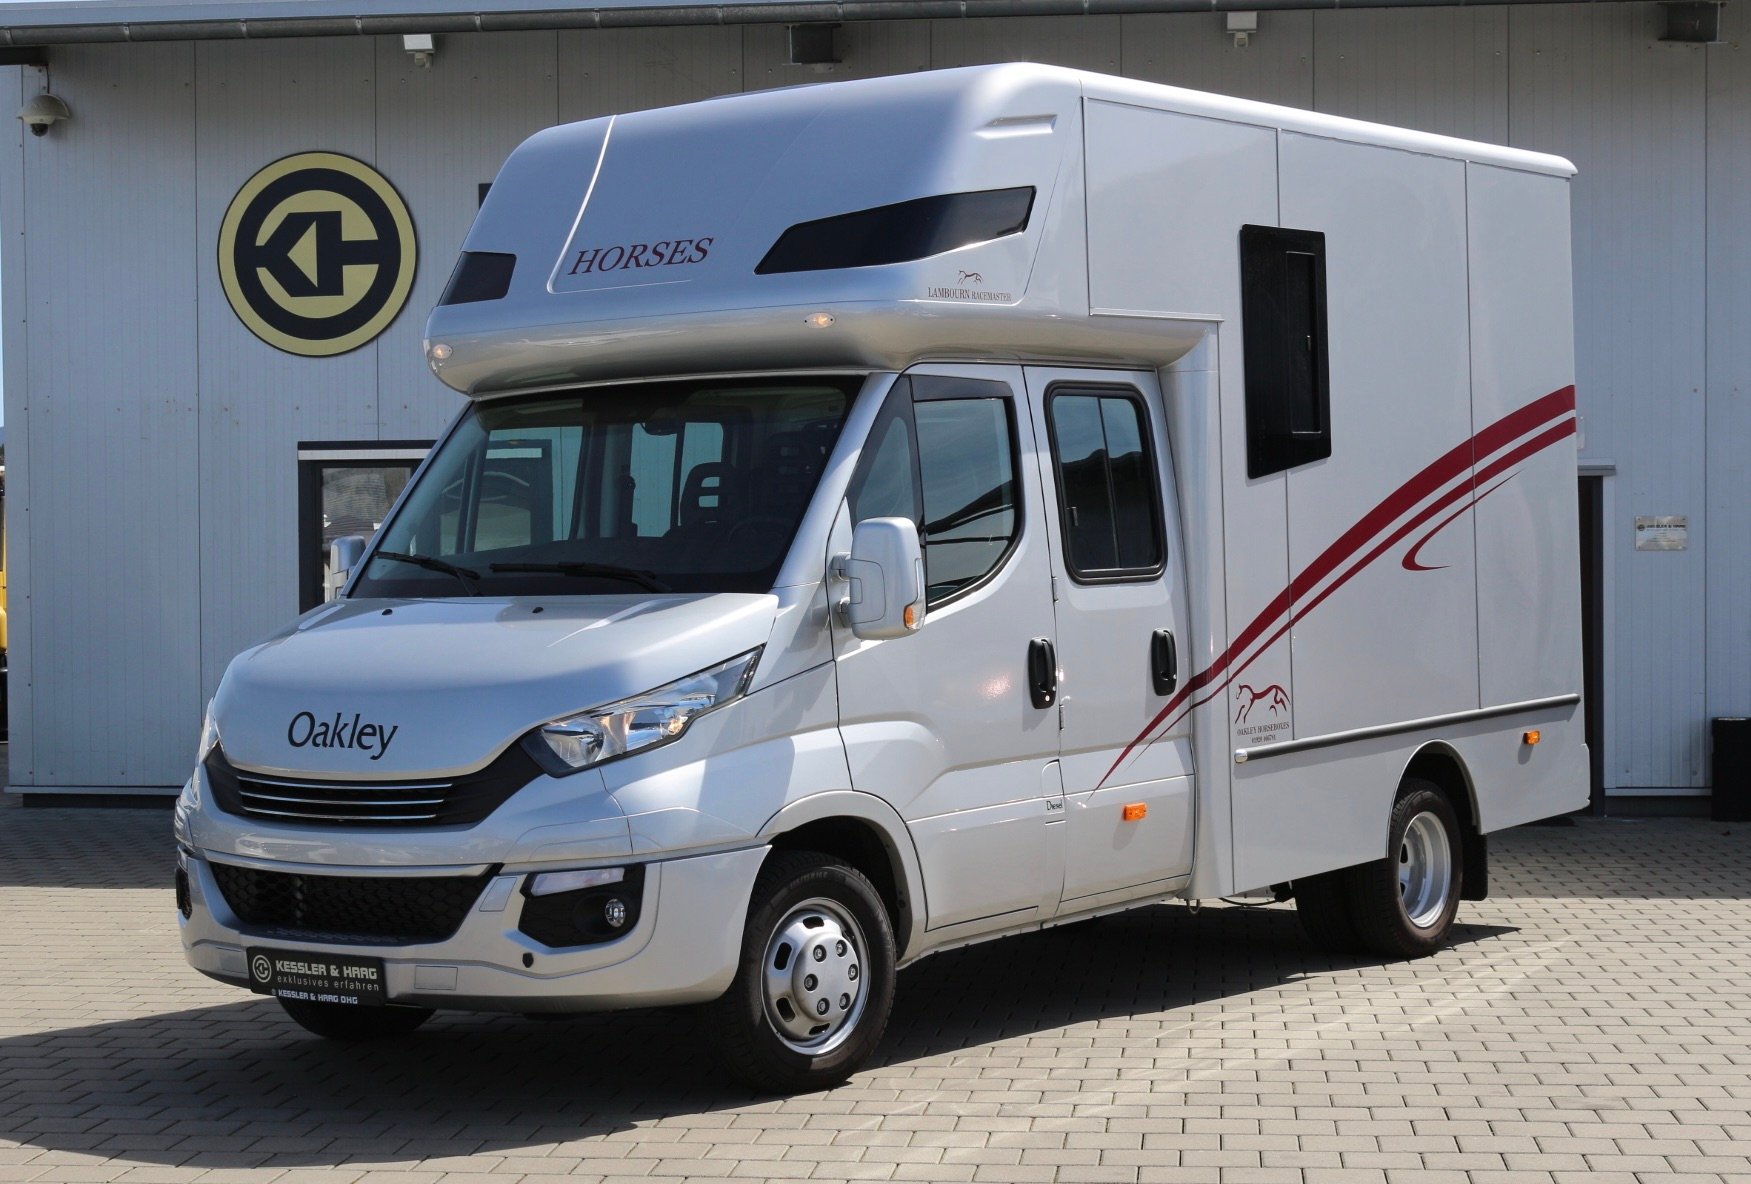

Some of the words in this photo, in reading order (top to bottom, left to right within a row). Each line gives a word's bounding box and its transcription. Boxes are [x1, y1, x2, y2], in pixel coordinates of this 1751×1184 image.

[568, 237, 714, 275] HORSES
[928, 287, 970, 299] LAMBOURN
[971, 290, 1012, 302] RACEMASTER
[288, 711, 399, 761] Oakley
[1237, 726, 1257, 736] OAKLEY
[276, 960, 327, 976] KESSLER
[330, 965, 340, 977] &
[343, 966, 378, 980] HAAG
[277, 975, 329, 988] exklusives
[334, 979, 380, 992] erfahren
[278, 989, 309, 1000] KESSLER
[310, 993, 317, 1001] &
[318, 994, 339, 1003] HAAG
